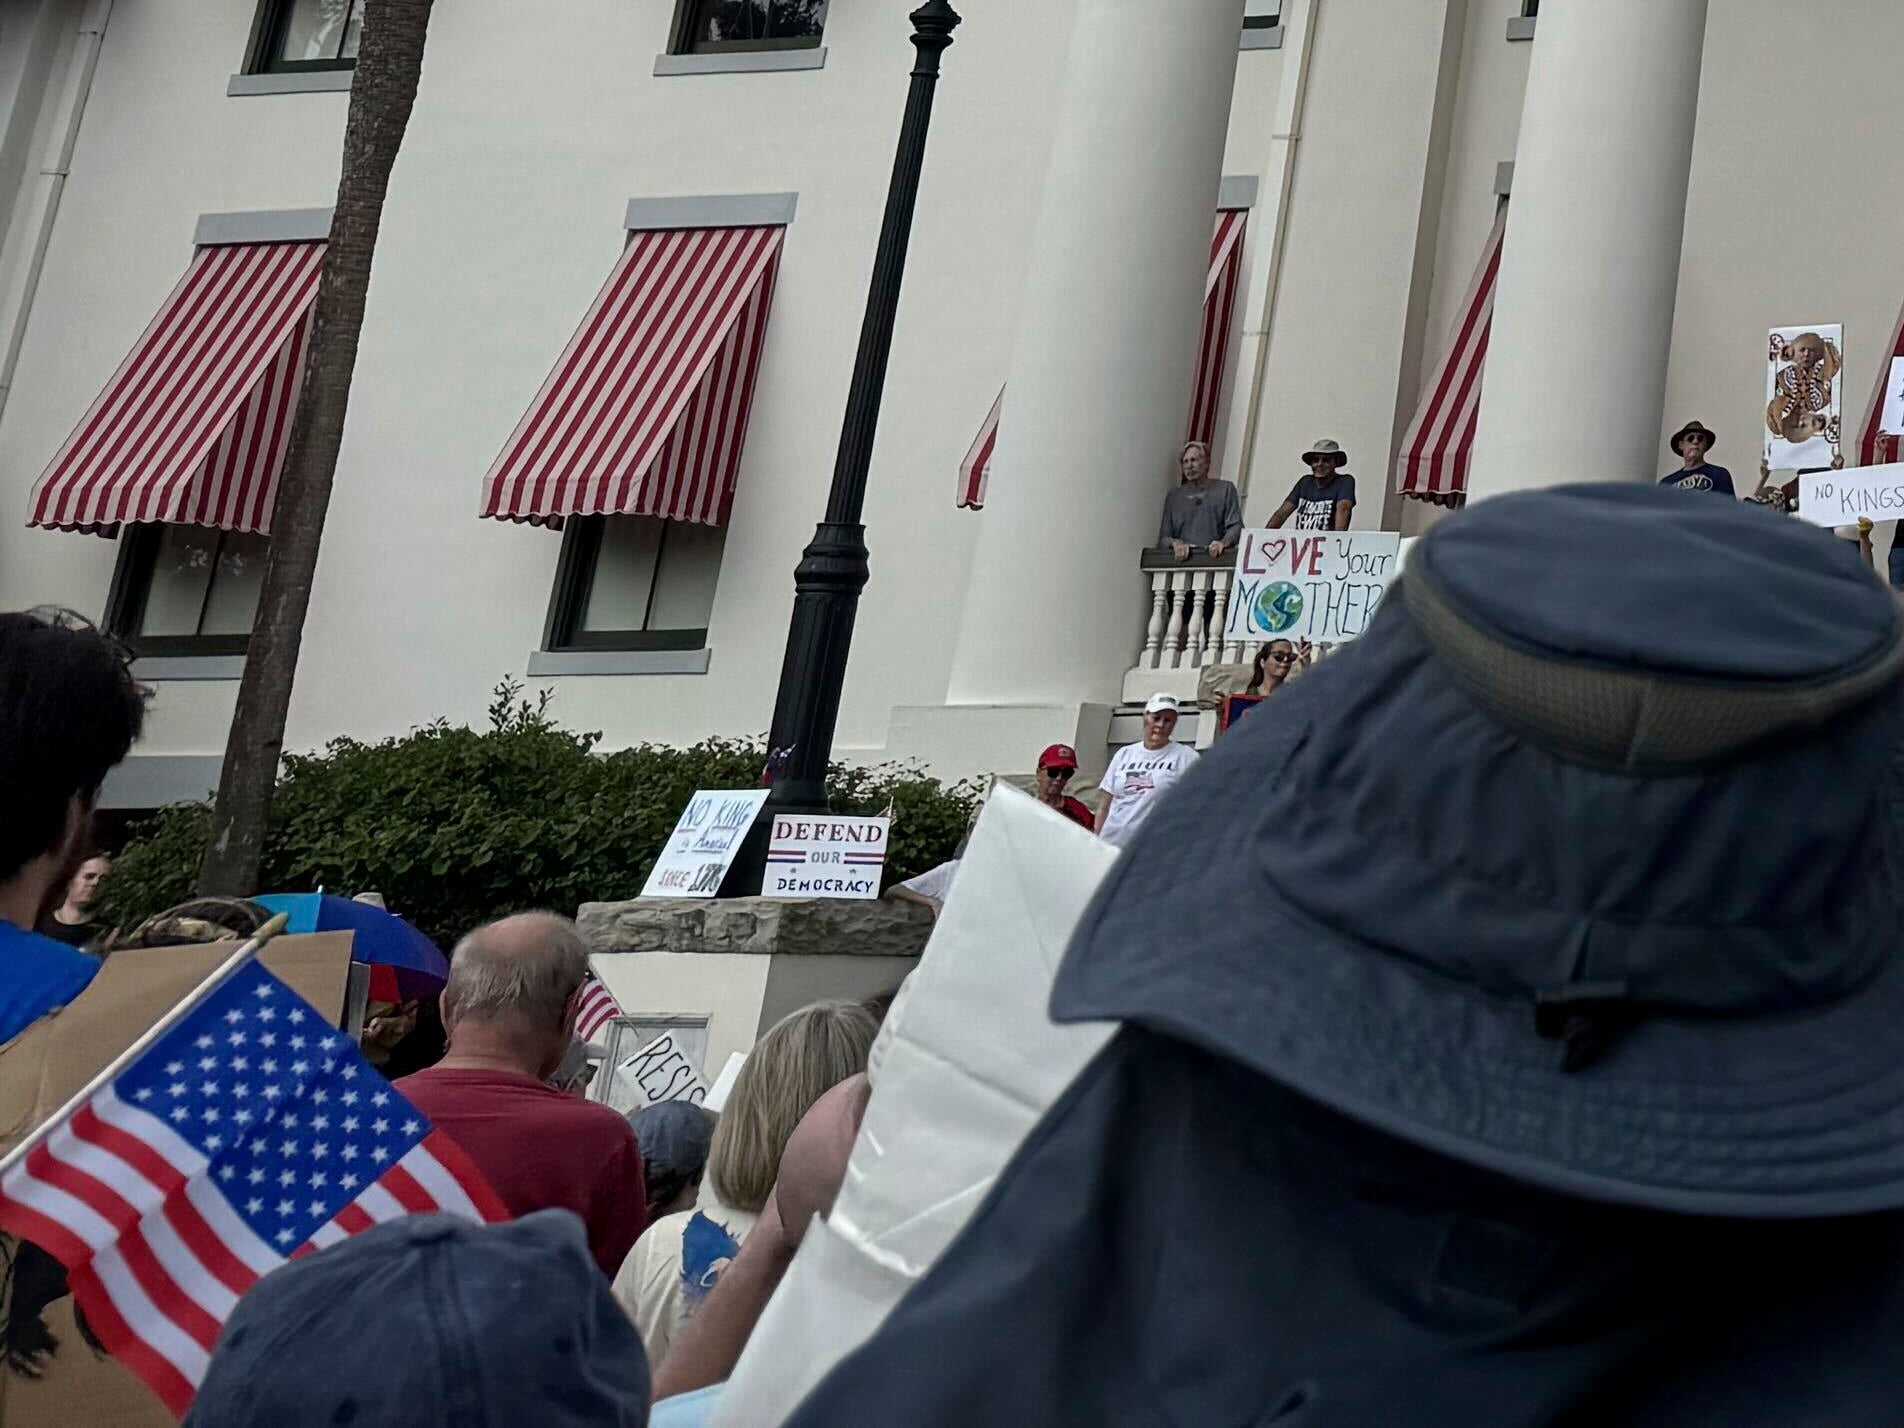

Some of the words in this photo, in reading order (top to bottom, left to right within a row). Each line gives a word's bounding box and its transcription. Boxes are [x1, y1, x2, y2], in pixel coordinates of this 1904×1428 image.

[1815, 483, 1834, 500] NO
[681, 799, 712, 827] NO
[710, 799, 754, 828] KING
[774, 821, 883, 843] DEFEND
[811, 851, 840, 864] OUR
[777, 878, 875, 893] DEMOCRACY
